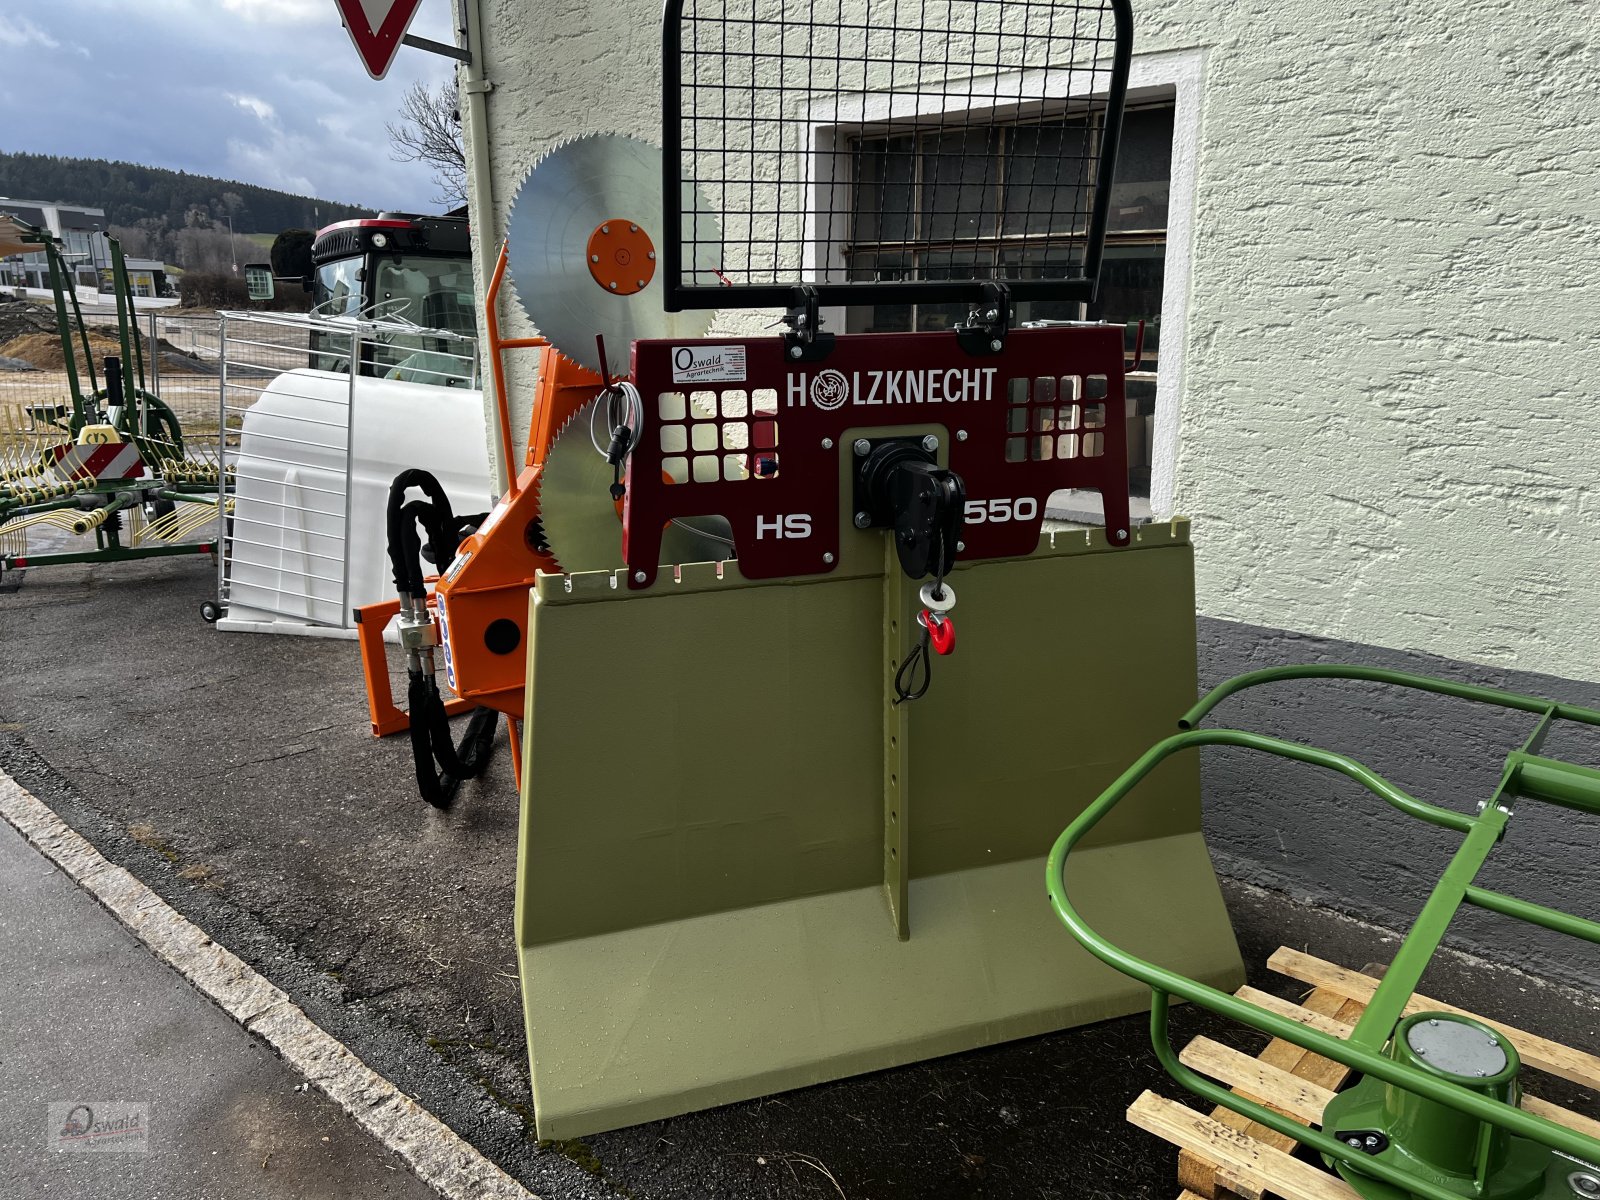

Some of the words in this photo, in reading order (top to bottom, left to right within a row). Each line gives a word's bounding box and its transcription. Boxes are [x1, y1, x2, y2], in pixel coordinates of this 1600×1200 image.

[675, 348, 721, 370] Oswald
[686, 366, 725, 378] Agrartechnik
[757, 514, 812, 540] HS
[964, 497, 1037, 524] 550
